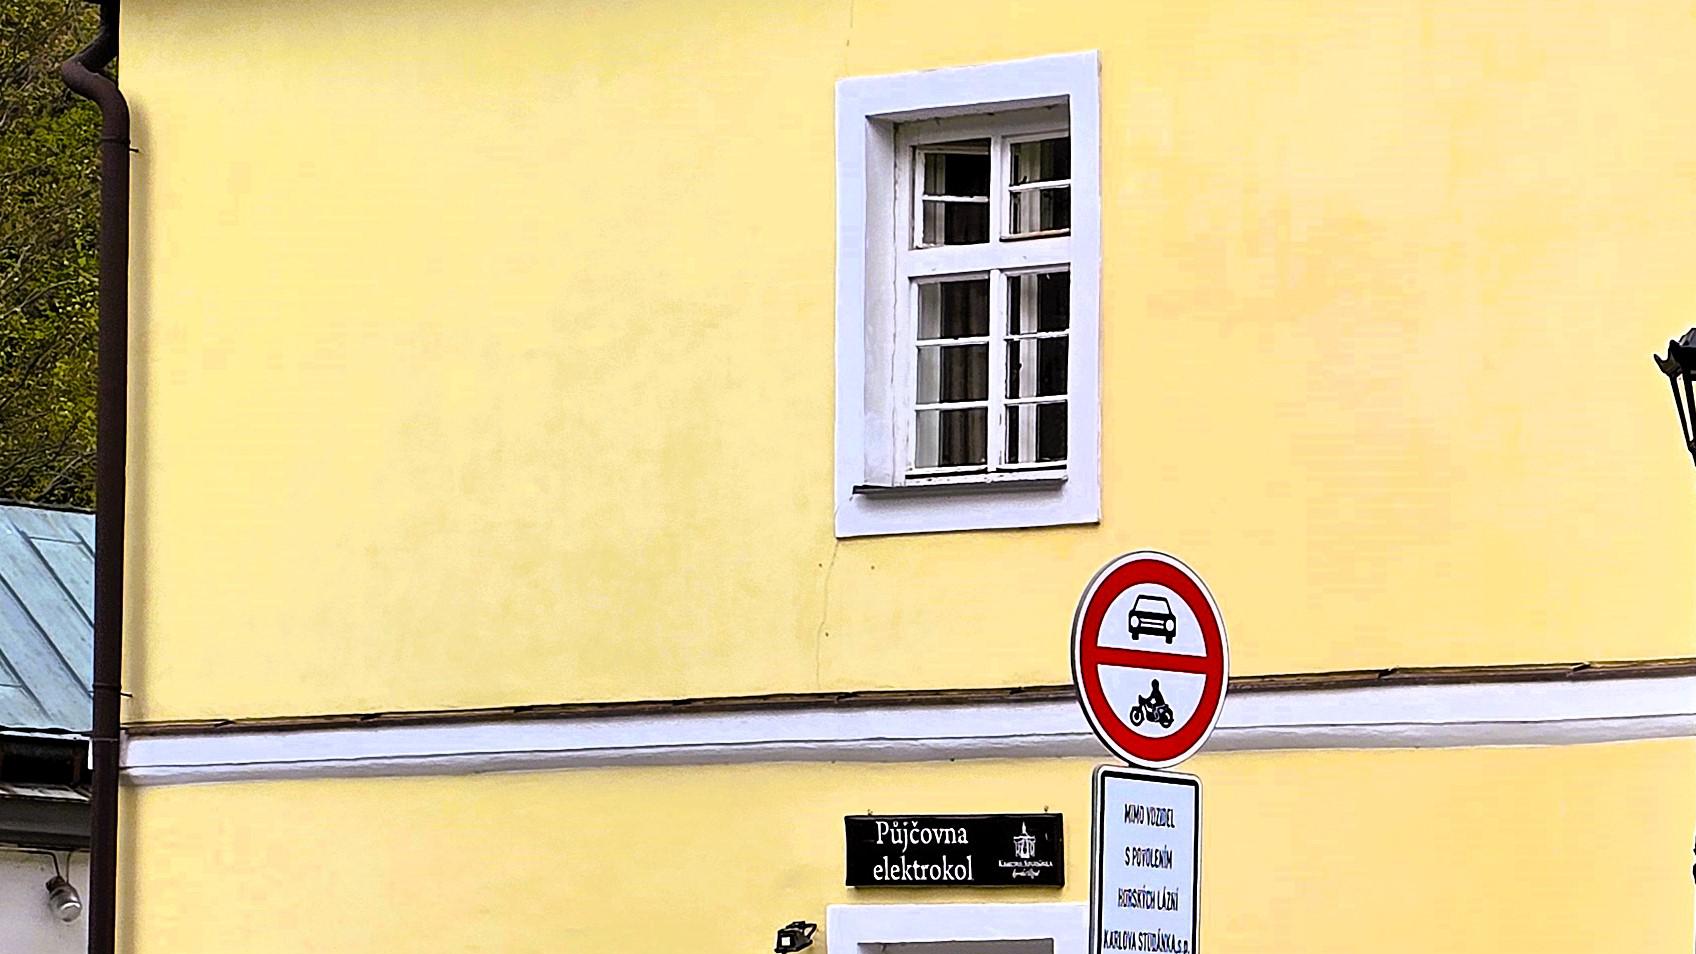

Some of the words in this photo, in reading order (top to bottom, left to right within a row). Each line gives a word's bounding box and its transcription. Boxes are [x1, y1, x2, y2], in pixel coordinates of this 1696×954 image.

[1124, 803, 1145, 825] MIMO
[1146, 806, 1175, 828] VOZIDEL
[875, 820, 969, 852] Půjčovna
[873, 855, 973, 881] elektrokol
[1125, 846, 1131, 866] S
[1157, 886, 1179, 911] LÁZNÍ
[1104, 929, 1137, 950] KARLOVA
